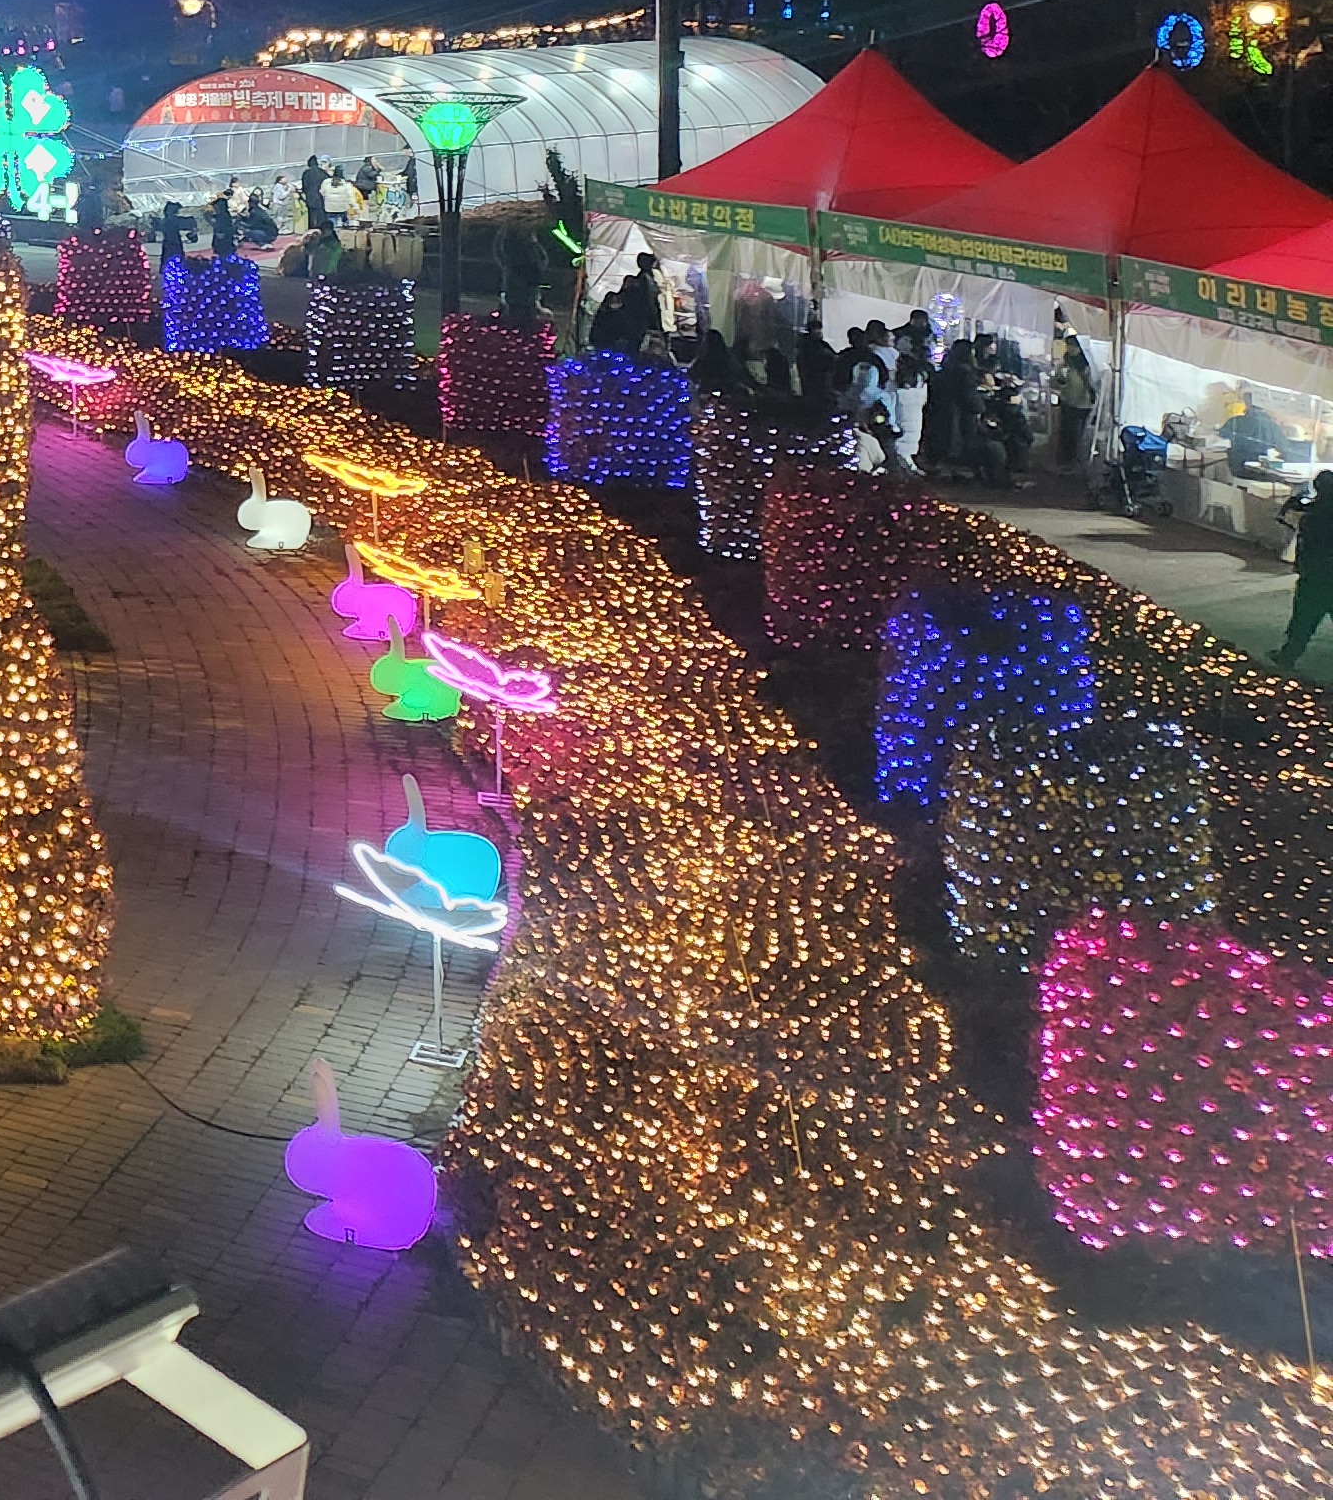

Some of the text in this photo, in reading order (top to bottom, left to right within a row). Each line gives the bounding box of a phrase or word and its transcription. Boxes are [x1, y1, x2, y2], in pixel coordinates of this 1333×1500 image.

[233, 89, 251, 110] 빛
[251, 90, 283, 109] 축제
[284, 90, 325, 111] 먹거리
[647, 194, 756, 233] 나비편의점
